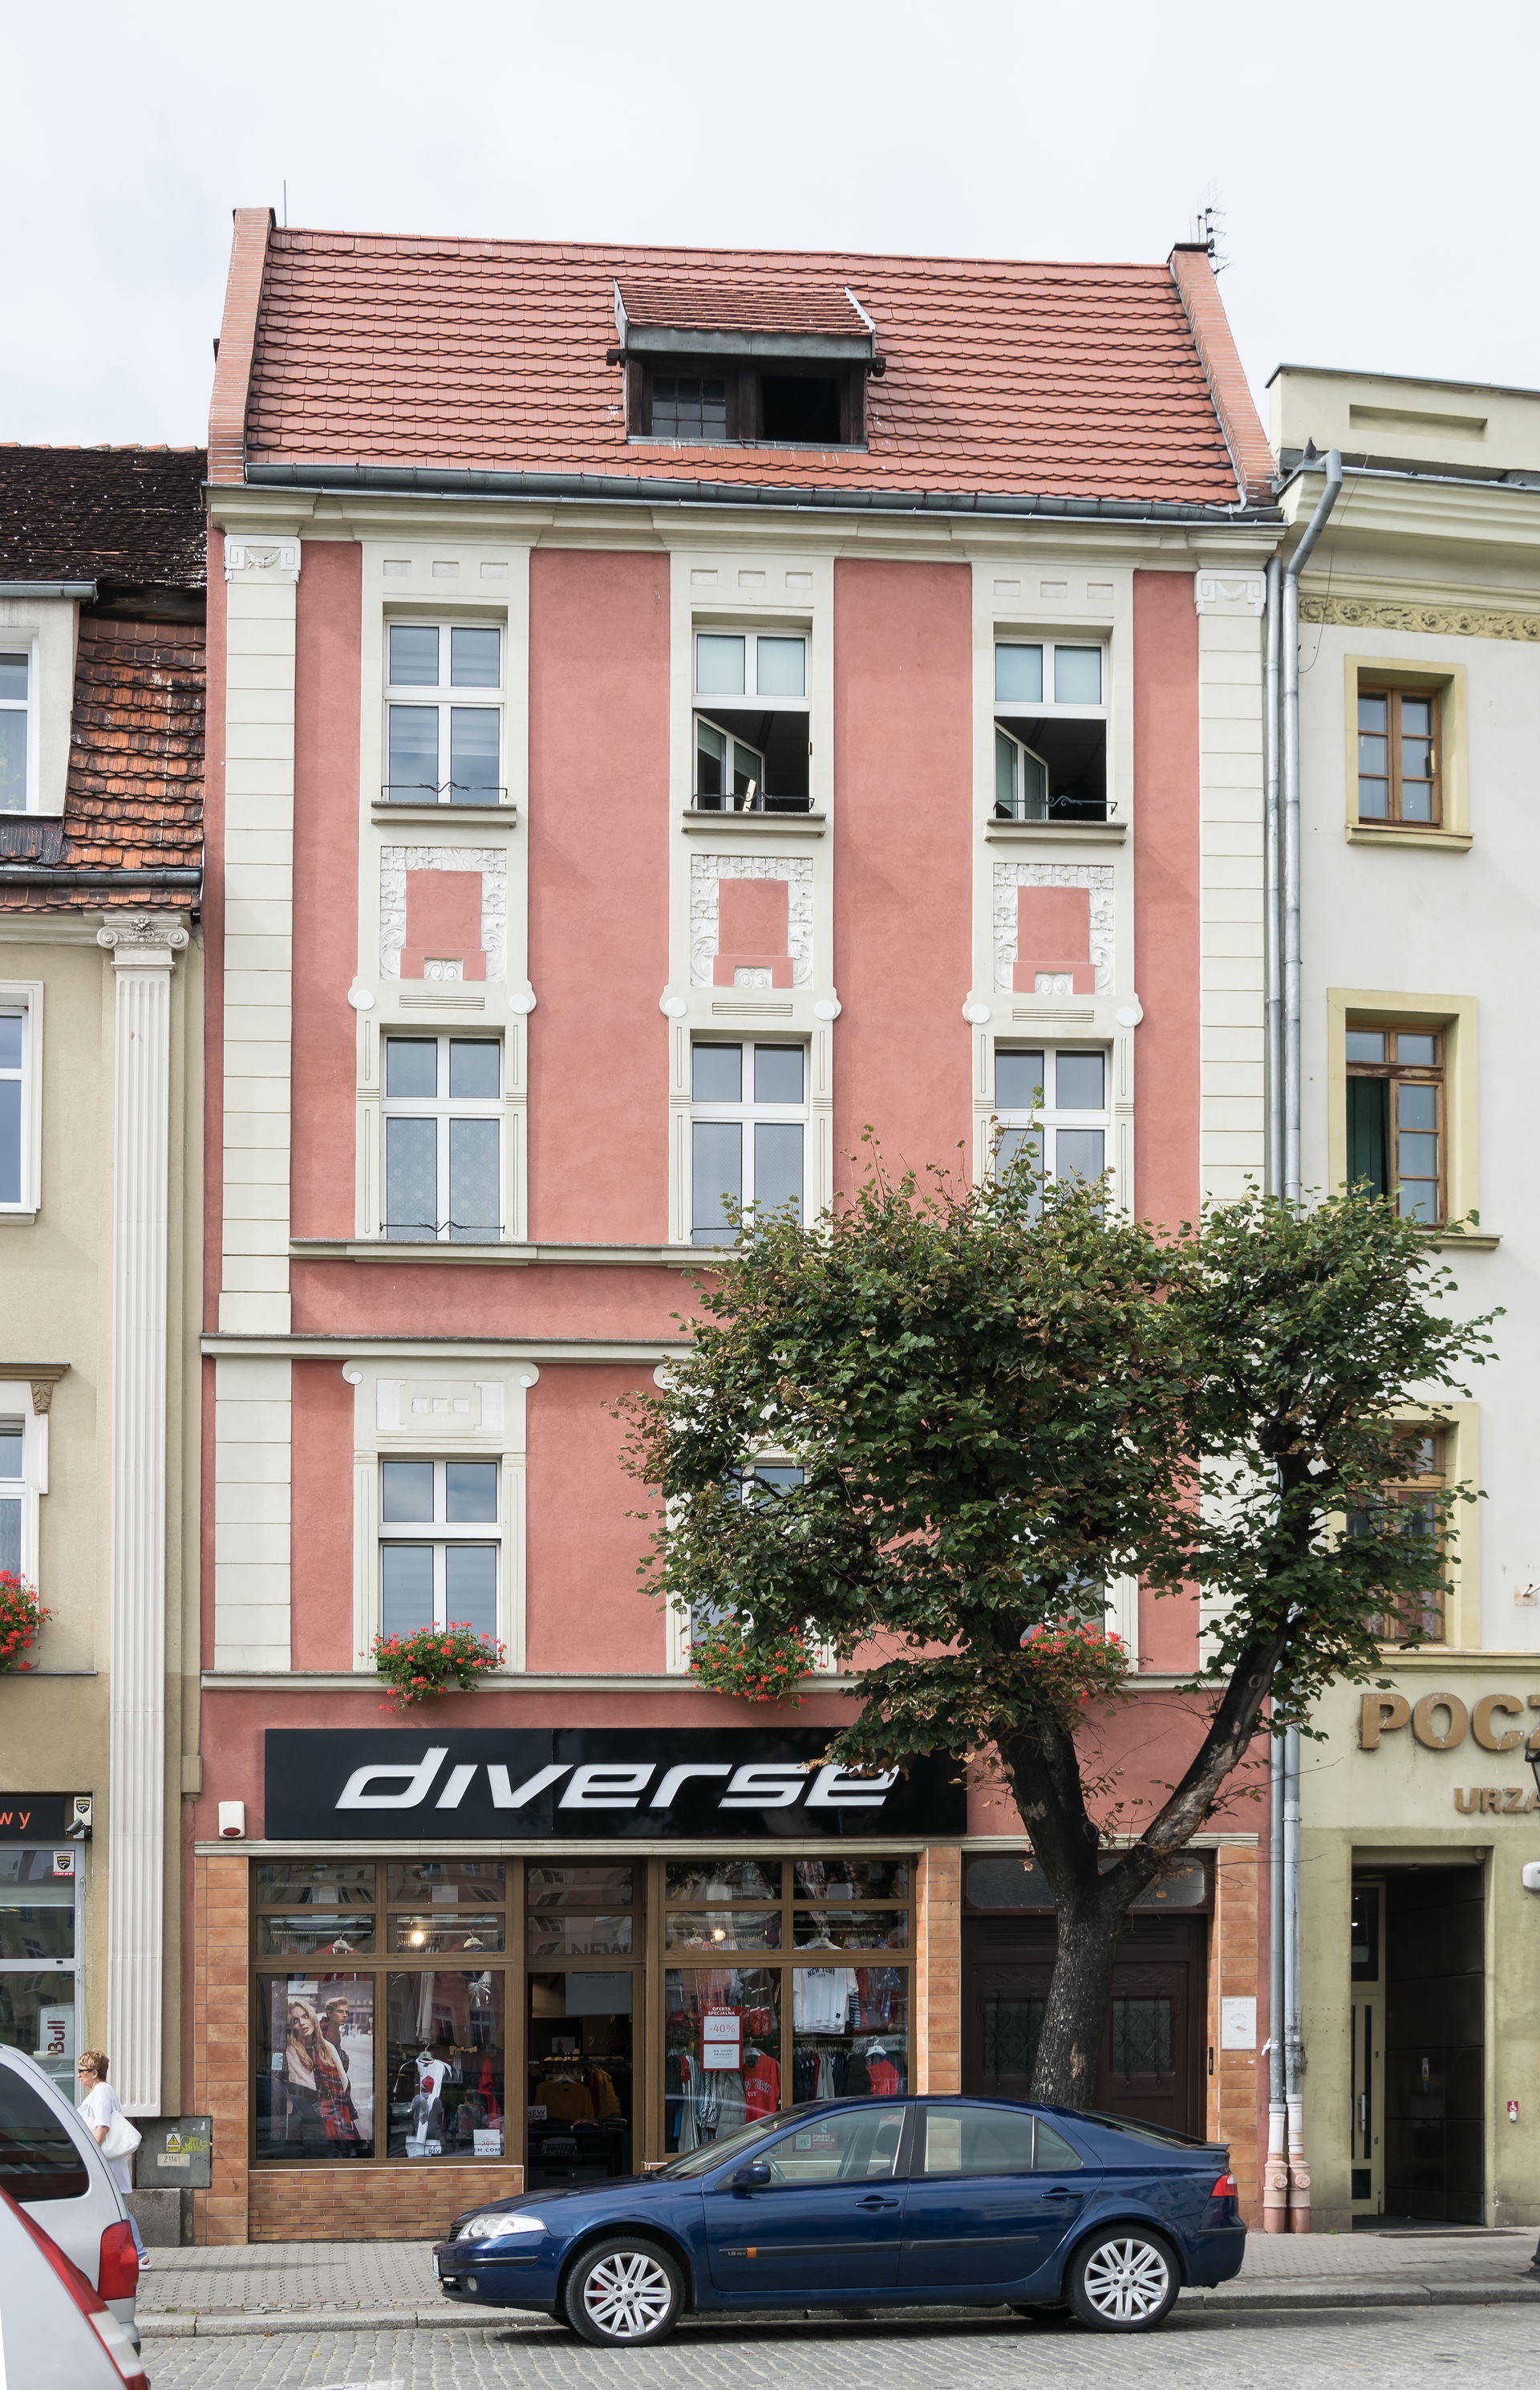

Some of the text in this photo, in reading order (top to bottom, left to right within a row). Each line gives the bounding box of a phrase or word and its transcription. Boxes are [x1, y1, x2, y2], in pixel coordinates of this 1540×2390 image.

[1359, 1693, 1540, 1751] POC
[335, 1747, 900, 1808] diverse
[709, 2023, 736, 2033] -40%
